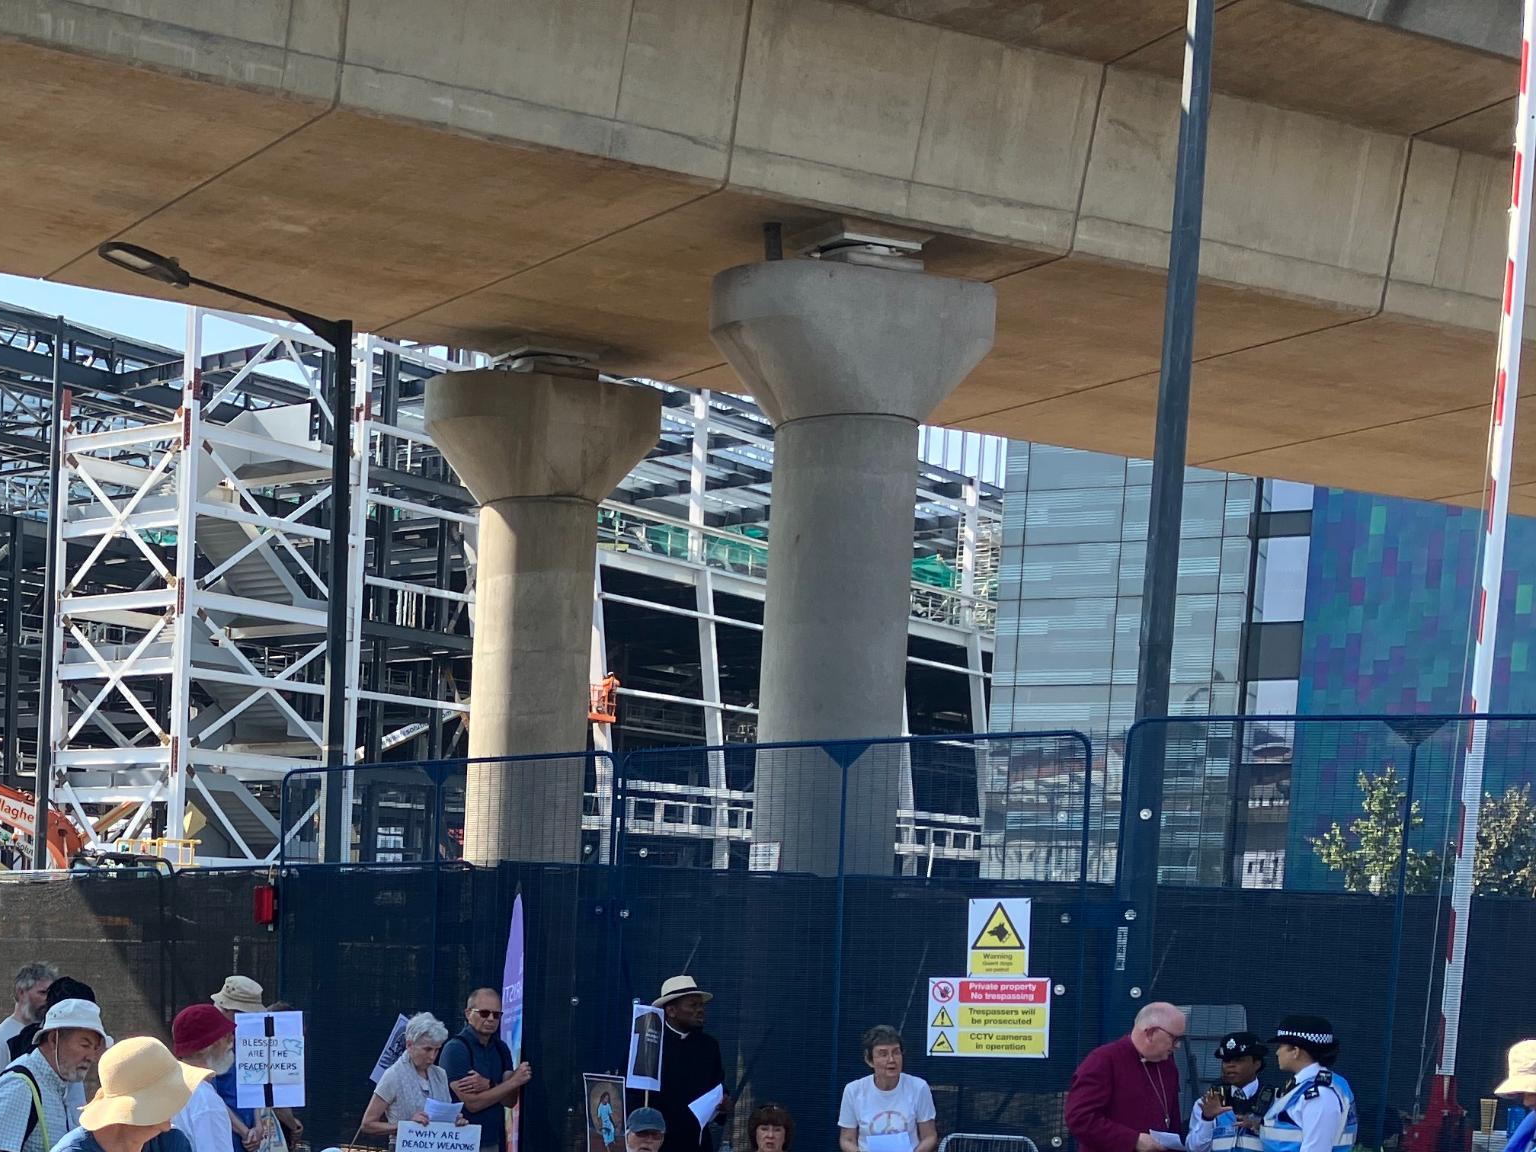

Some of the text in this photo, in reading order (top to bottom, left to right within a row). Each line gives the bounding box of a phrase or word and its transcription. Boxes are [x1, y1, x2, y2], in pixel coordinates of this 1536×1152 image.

[983, 953, 1013, 961] Warning
[969, 982, 1037, 992] Private property
[984, 992, 1034, 1001] trespassing
[969, 1008, 1019, 1016] Trespassers
[984, 1017, 1032, 1026] prosecuted
[995, 1033, 1033, 1041] cameras
[242, 1038, 279, 1047] BLESSED
[987, 1043, 1026, 1051] operation
[248, 1049, 289, 1058] ARE THE
[238, 1062, 298, 1071] PEACEMAKERS
[440, 1131, 461, 1140] ARE
[401, 1140, 475, 1151] DEADLY WEAPONS
